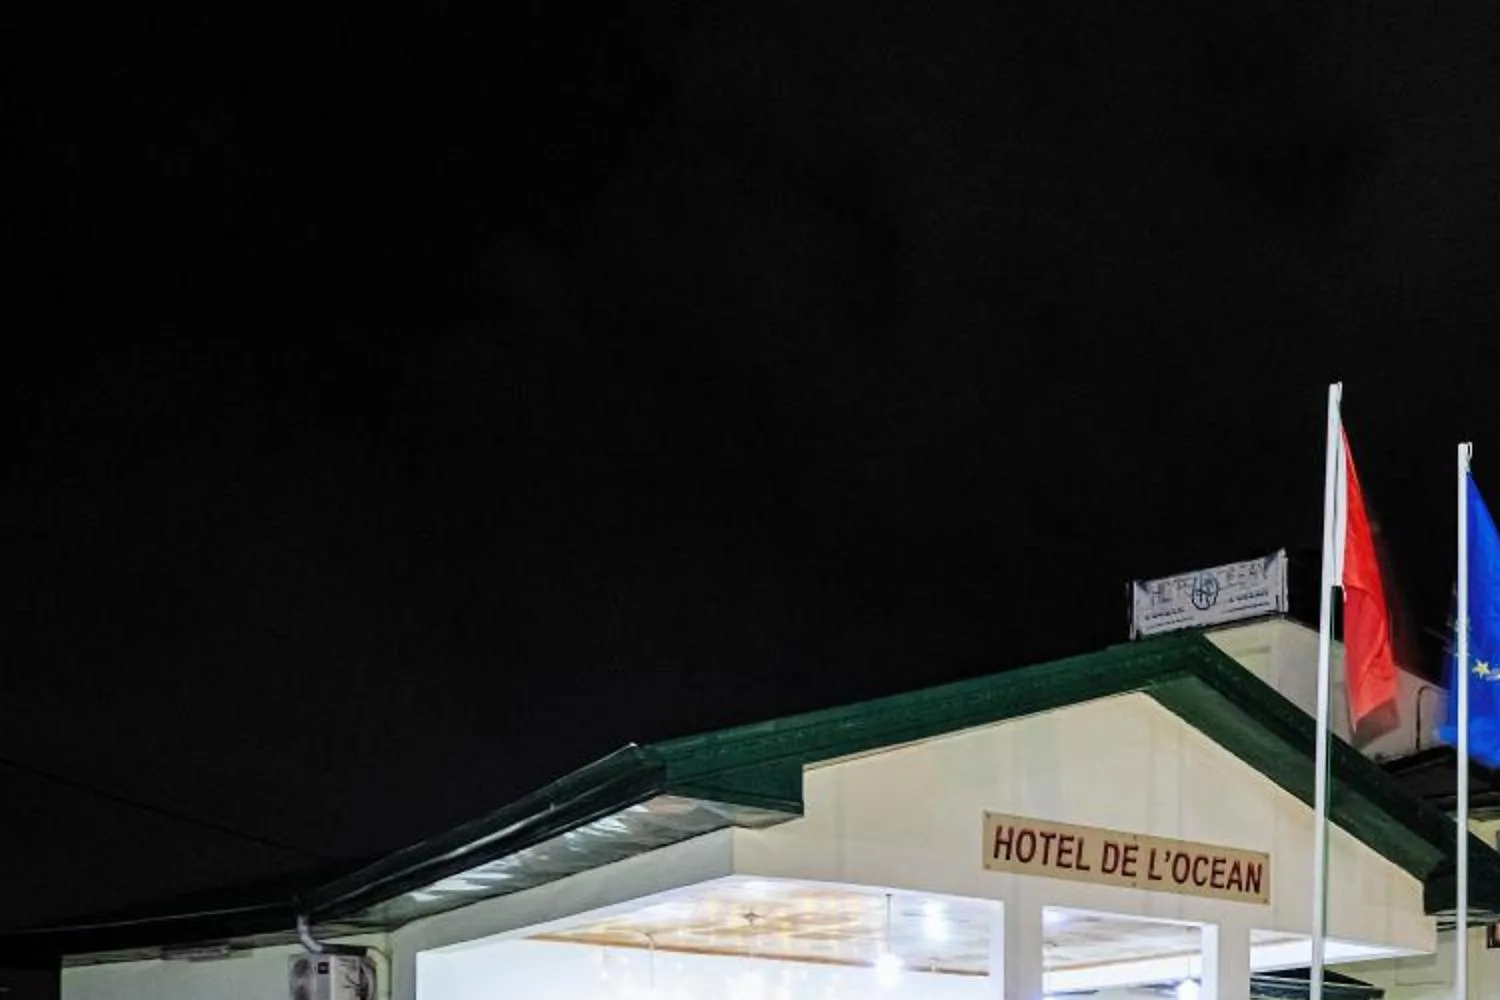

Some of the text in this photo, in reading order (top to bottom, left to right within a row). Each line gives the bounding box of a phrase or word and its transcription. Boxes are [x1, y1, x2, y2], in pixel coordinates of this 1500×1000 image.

[992, 825, 1263, 894] HOTEL DE L'OCEAN
